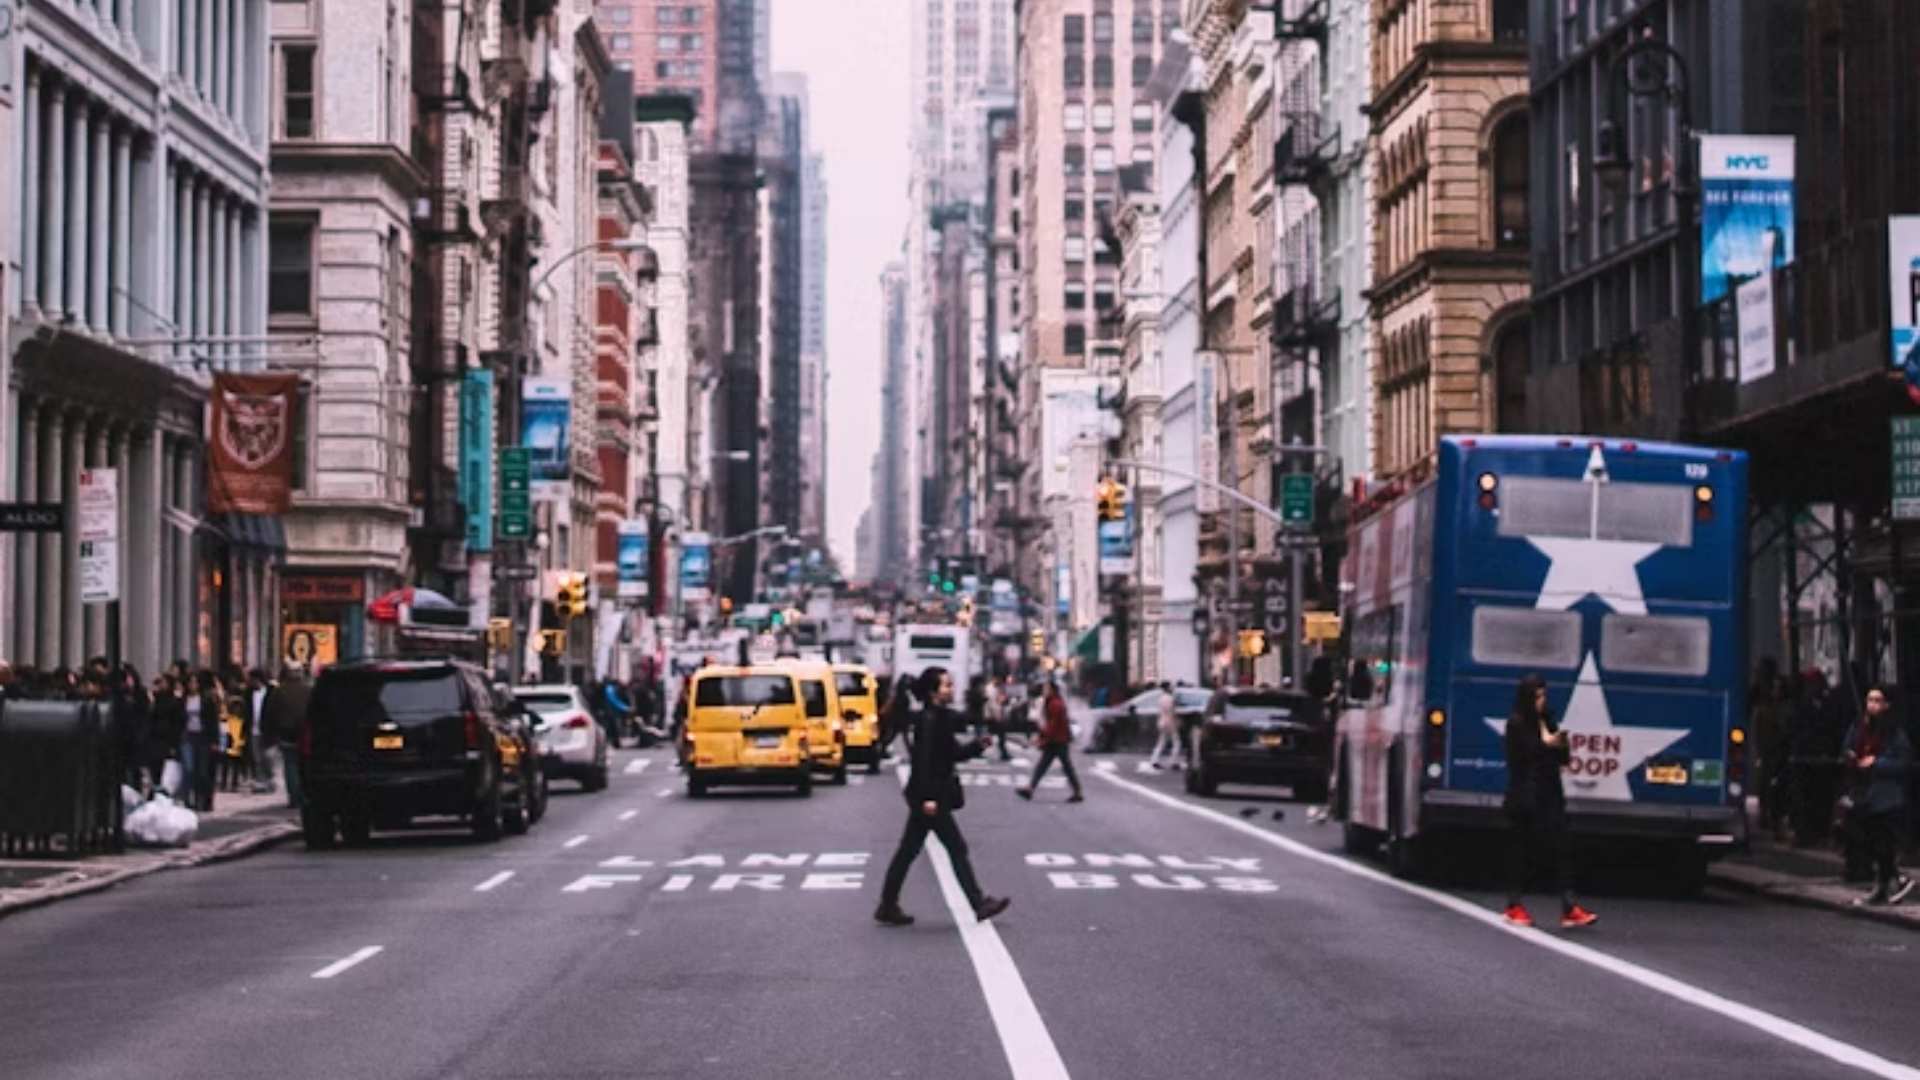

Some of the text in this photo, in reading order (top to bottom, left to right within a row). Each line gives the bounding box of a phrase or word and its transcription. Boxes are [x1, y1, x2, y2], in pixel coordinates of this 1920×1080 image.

[1726, 154, 1768, 169] NYC
[1265, 577, 1288, 635] CB2
[1570, 734, 1621, 754] PEN
[1563, 756, 1619, 777] OOP
[596, 852, 871, 868] LANE
[1024, 853, 1262, 871] ONLY
[561, 873, 865, 891] FIRE
[1046, 872, 1280, 892] BUS
